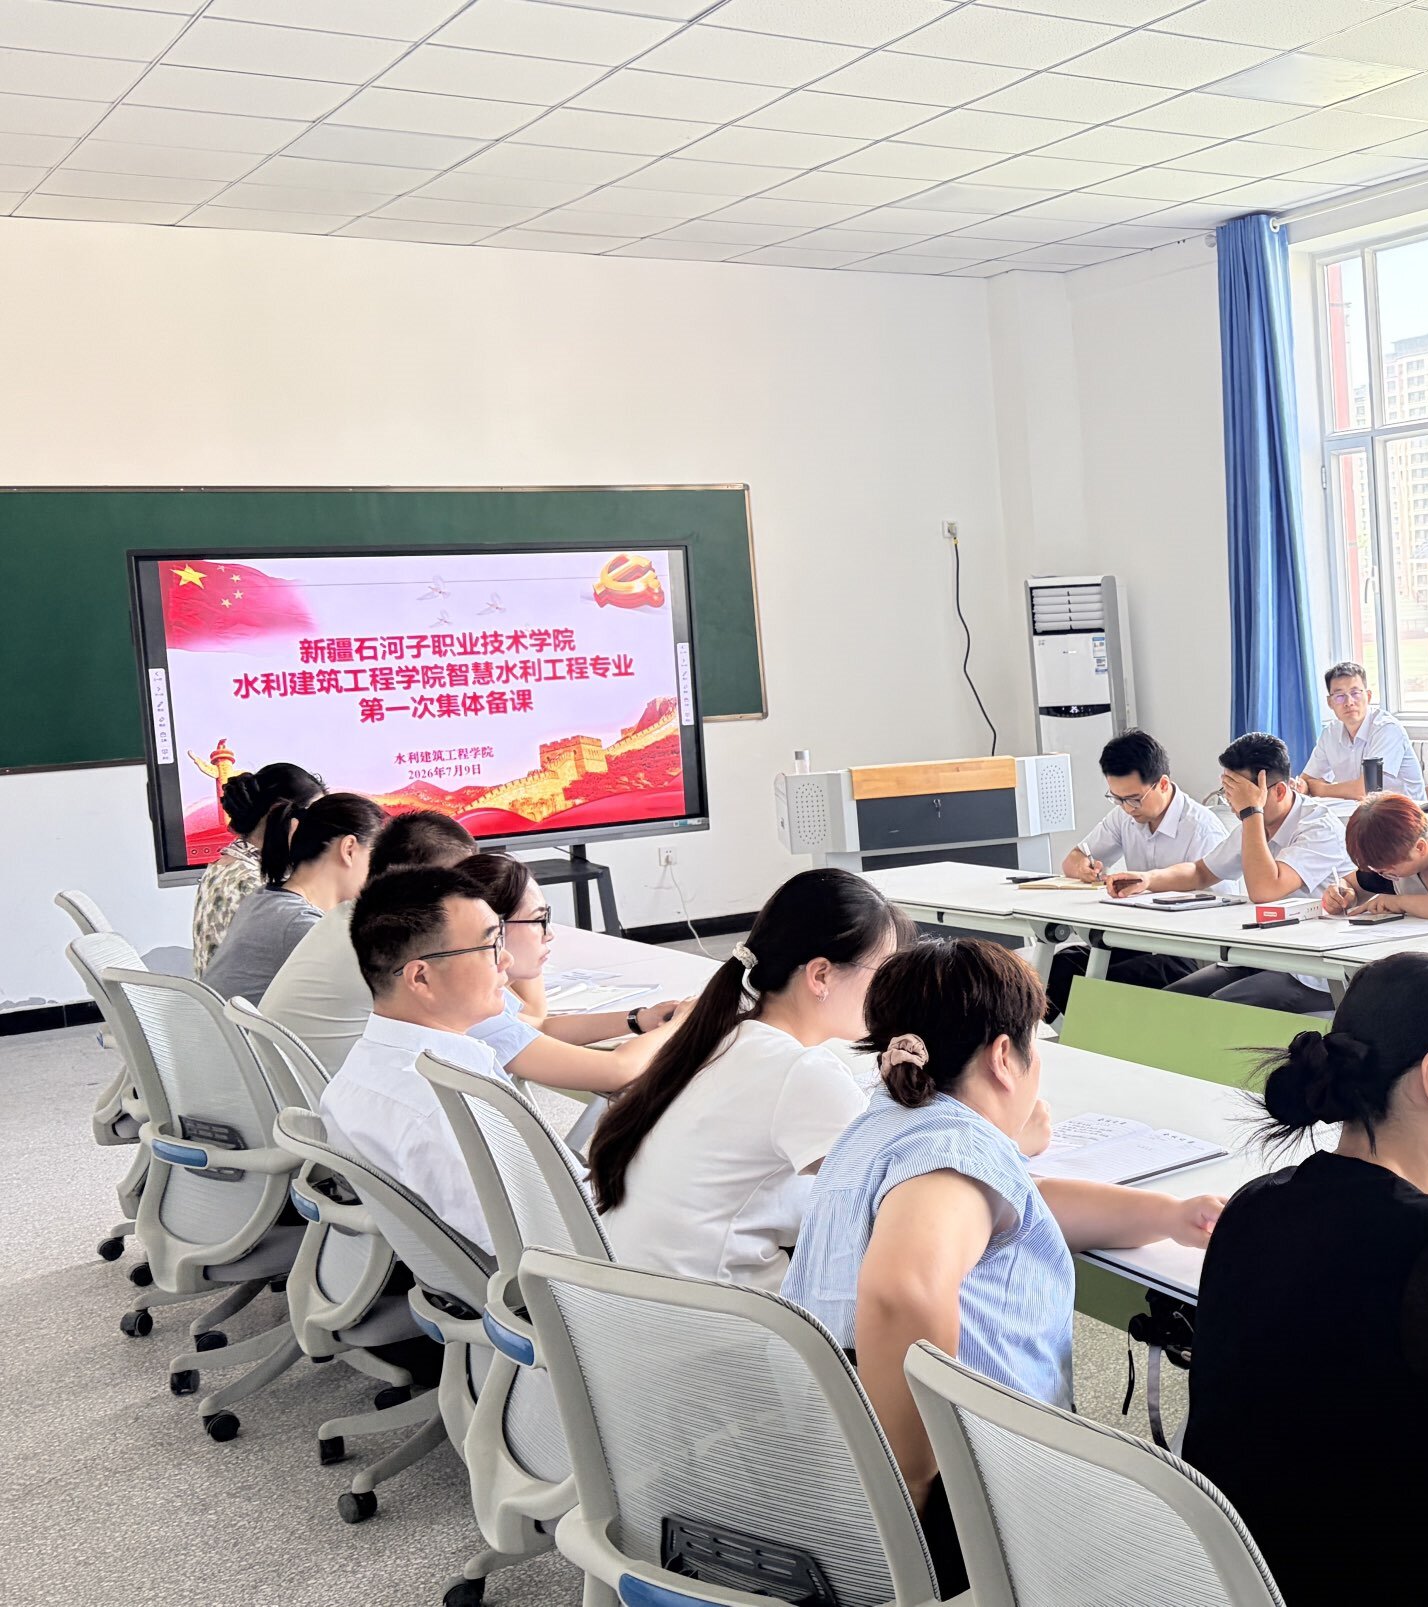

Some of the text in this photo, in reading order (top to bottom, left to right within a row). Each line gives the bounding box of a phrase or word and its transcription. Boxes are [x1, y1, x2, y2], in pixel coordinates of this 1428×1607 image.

[299, 628, 576, 664] 新疆石河子职业技术学院
[233, 655, 635, 699] 水利建筑工程学院智慧水利工程专业
[358, 689, 534, 723] 第一次集体备课
[394, 746, 494, 765] 水利建筑工程学院
[408, 764, 481, 779] 2026年7月9日
